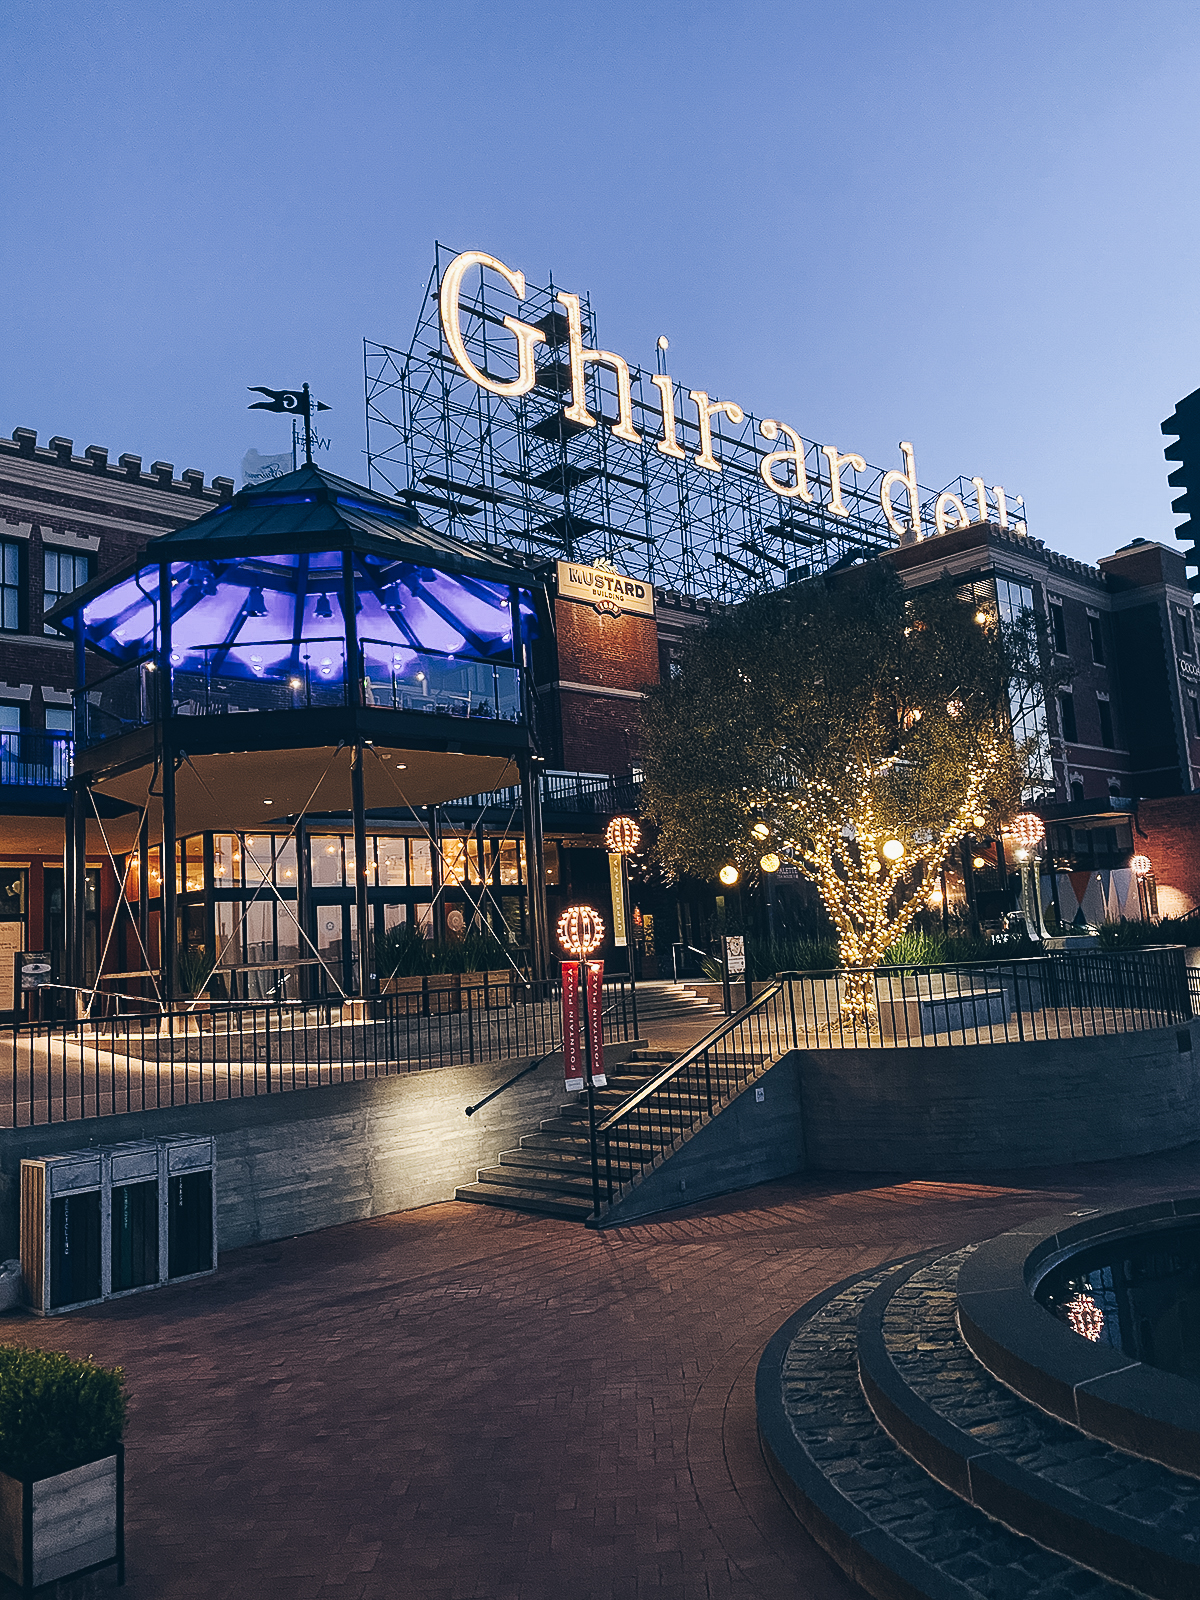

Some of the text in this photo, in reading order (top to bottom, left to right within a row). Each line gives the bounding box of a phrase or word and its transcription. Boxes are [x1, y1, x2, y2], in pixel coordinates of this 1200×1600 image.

[568, 567, 646, 599] MUSTARD
[592, 588, 625, 602] BUILDING
[568, 1010, 576, 1071] FOUNTAIN
[592, 1008, 600, 1068] FOUNTAIN
